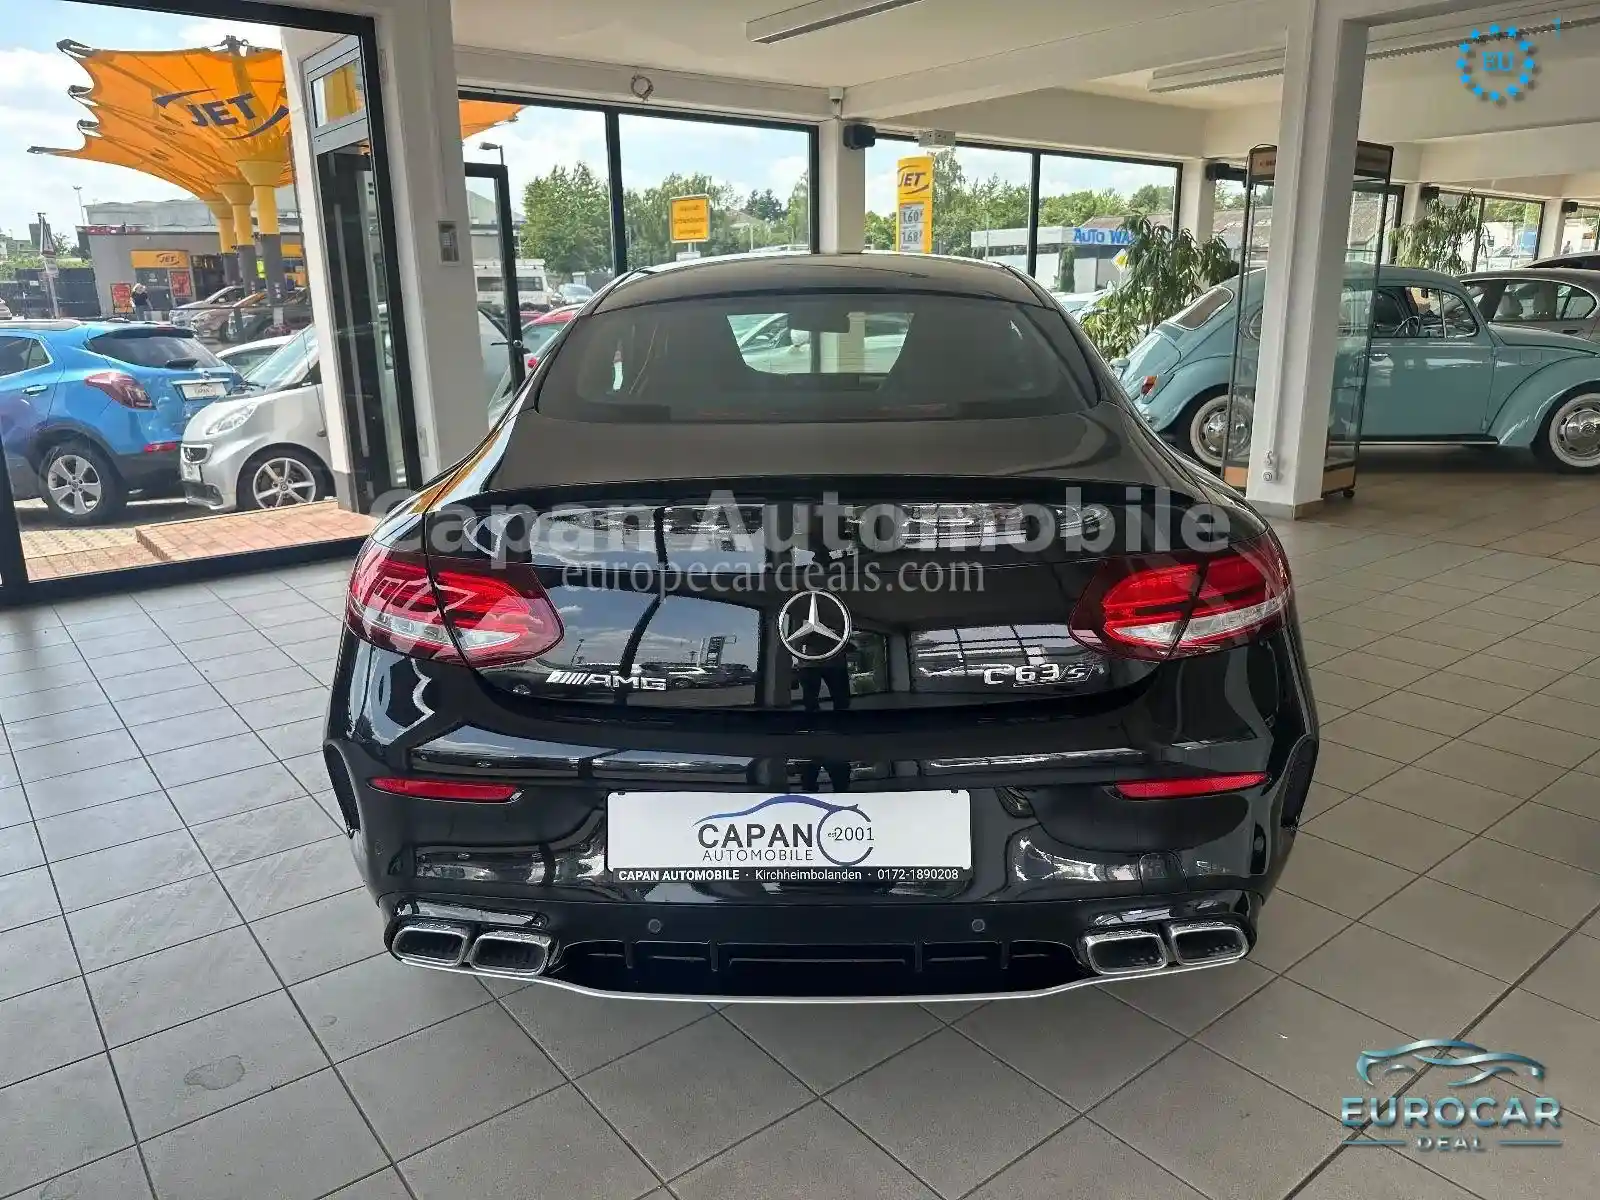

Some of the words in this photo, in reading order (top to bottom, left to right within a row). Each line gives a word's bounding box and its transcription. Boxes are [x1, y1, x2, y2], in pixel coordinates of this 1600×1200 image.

[185, 92, 256, 127] JET
[898, 171, 926, 187] JET
[161, 255, 176, 263] JET
[698, 823, 813, 848] CAPAN
[834, 827, 874, 841] 2001
[702, 849, 814, 861] AUTOMOBILE
[618, 870, 660, 881] CAPAN
[663, 870, 740, 881] AUTOMOBILE
[755, 869, 862, 880] Kirchheimbolanden
[877, 869, 959, 880] 0172-1890208
